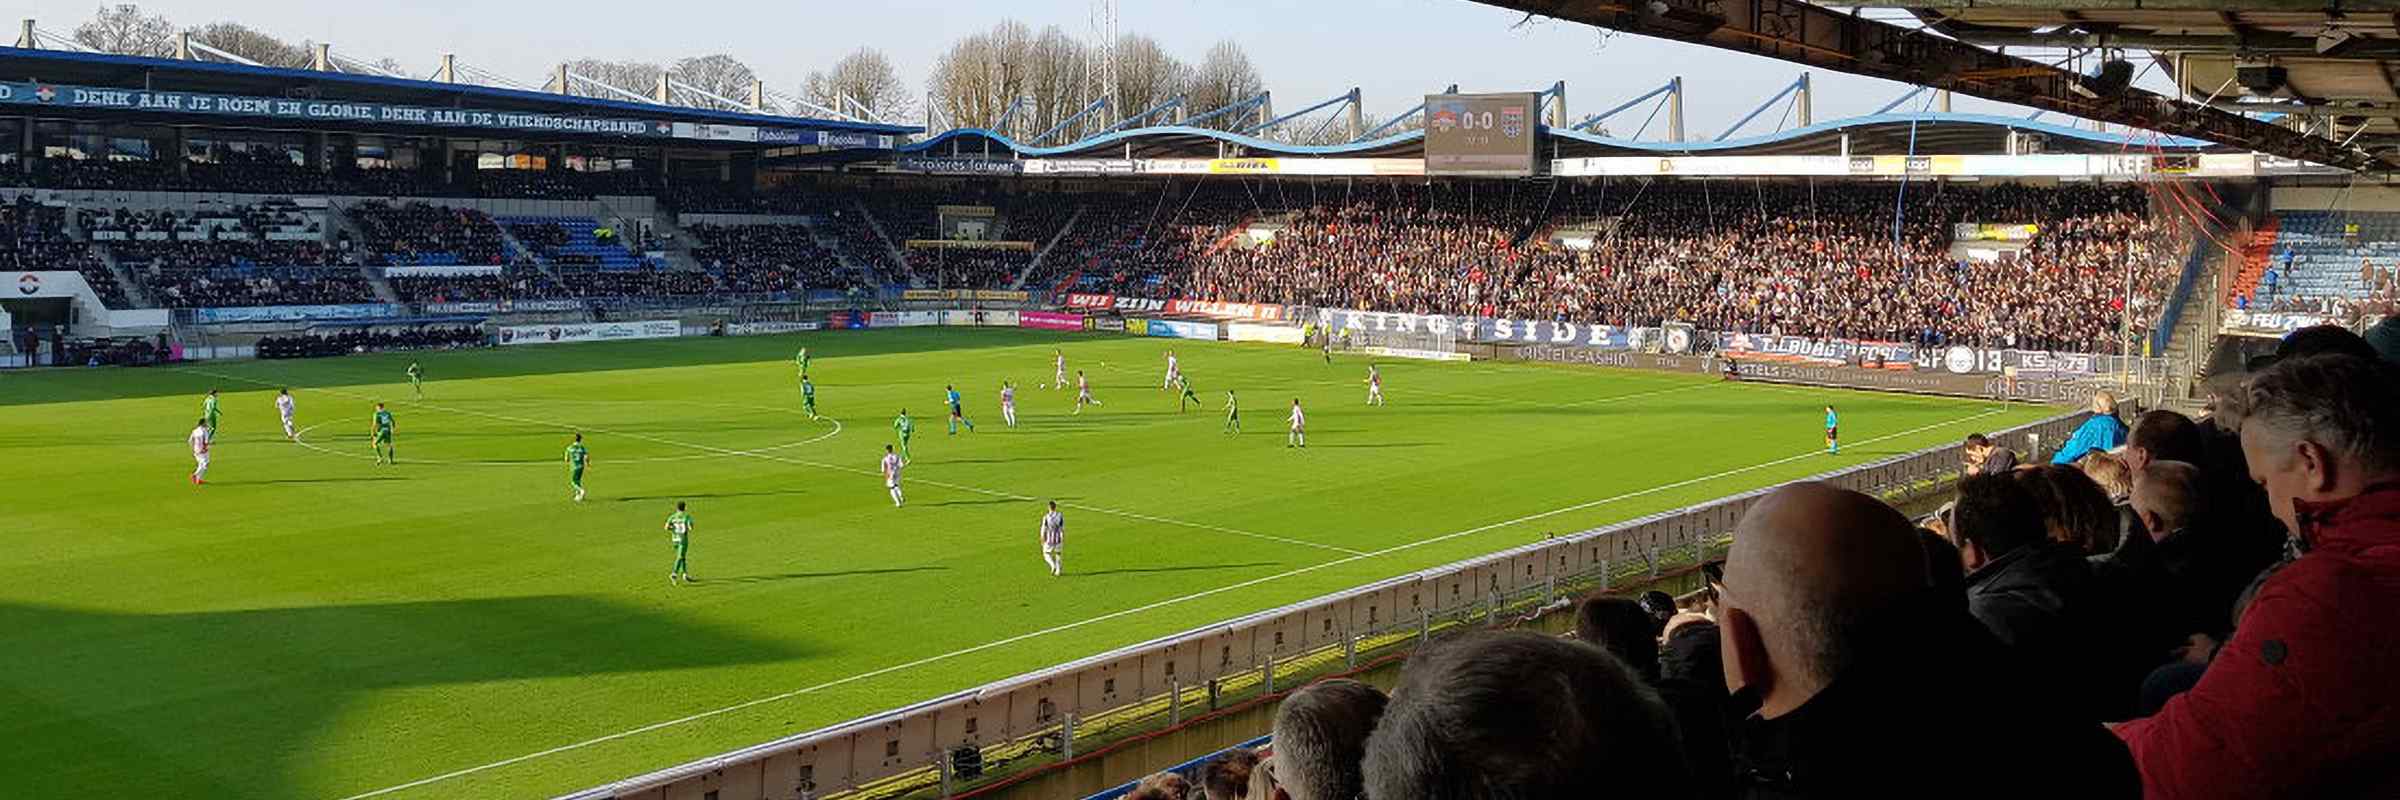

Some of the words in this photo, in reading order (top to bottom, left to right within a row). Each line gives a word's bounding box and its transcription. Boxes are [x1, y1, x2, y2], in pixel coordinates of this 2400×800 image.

[72, 89, 130, 106] DENK
[138, 93, 181, 110] AAN
[187, 96, 211, 110] JE
[218, 97, 271, 113] ROEM
[276, 100, 301, 115] EN
[381, 107, 426, 121] DENK
[432, 110, 467, 124] AAN
[472, 112, 492, 126] DE
[498, 113, 648, 134] VRIENDSCHAPSBAND
[1115, 297, 1166, 311] ZIJN
[1174, 301, 1255, 317] WILLEM
[1346, 310, 1450, 335] KING
[1494, 318, 1612, 346] SIDE
